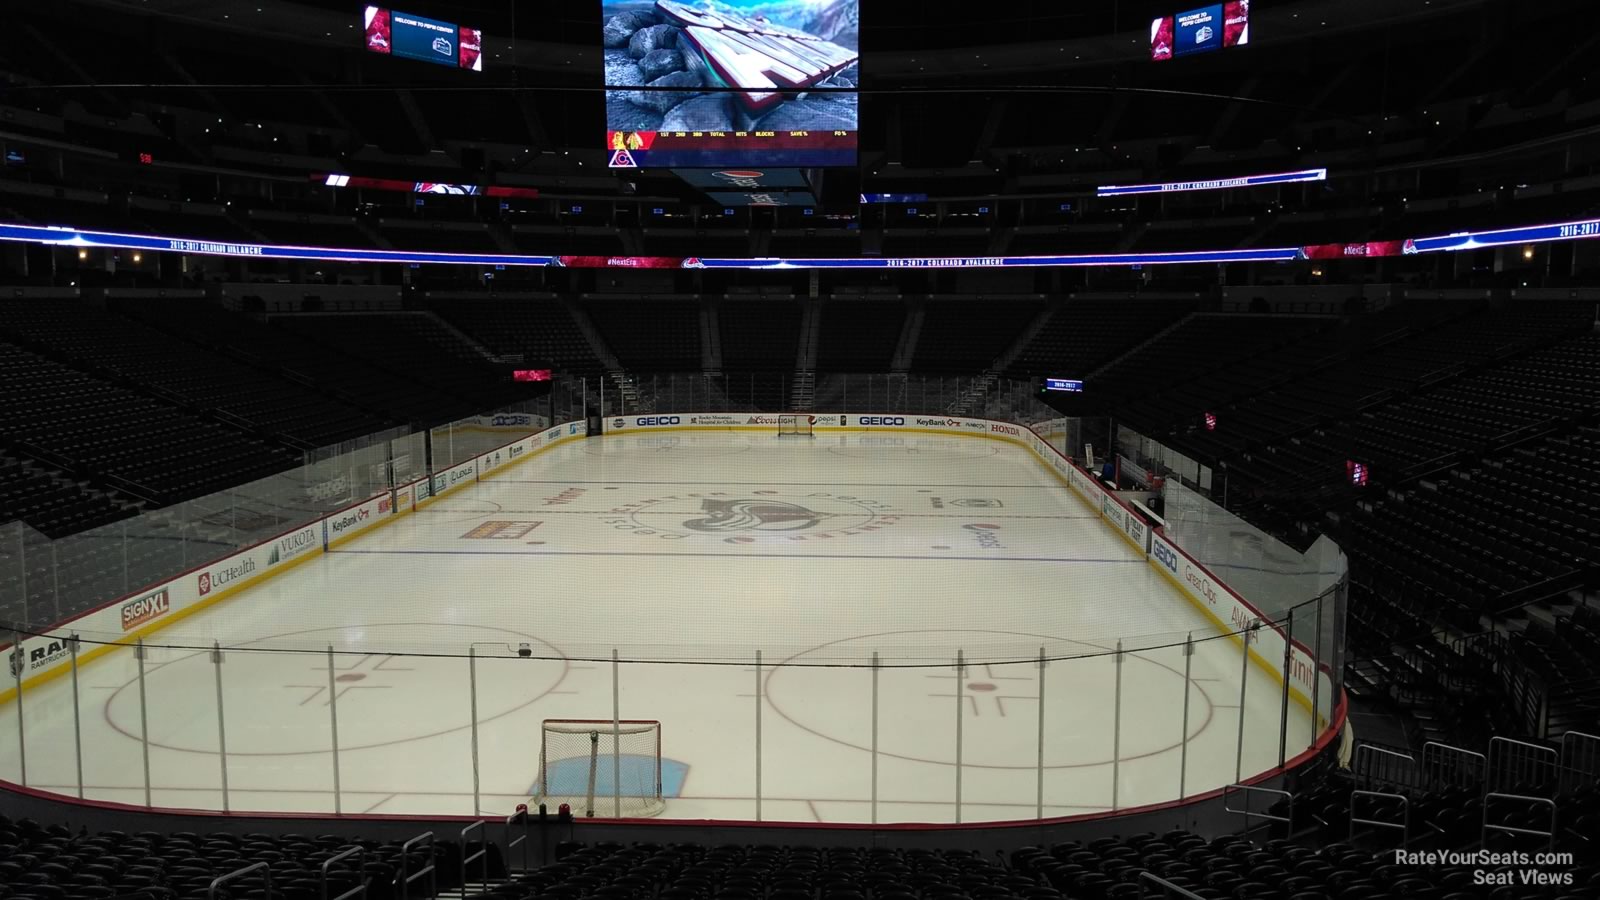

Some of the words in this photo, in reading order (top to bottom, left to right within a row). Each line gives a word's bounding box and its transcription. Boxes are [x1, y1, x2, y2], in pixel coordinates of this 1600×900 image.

[394, 16, 417, 26] WELCOME
[1179, 13, 1200, 23] WELCOME
[1560, 223, 1599, 237] 2016-2017
[170, 240, 199, 251] 2016-2017
[200, 243, 226, 253] COLORADO
[227, 245, 263, 255] AVALANCHE
[965, 258, 1004, 266] AVALANCHE
[636, 416, 681, 427] GEICO
[859, 416, 905, 426] GEICO
[916, 418, 946, 427] KeyBank
[991, 424, 1020, 436] HONDA
[332, 513, 358, 532] KeyBank
[281, 528, 316, 552] VUKOTA
[1153, 539, 1178, 573] GEICO
[211, 557, 256, 588] UCHealth
